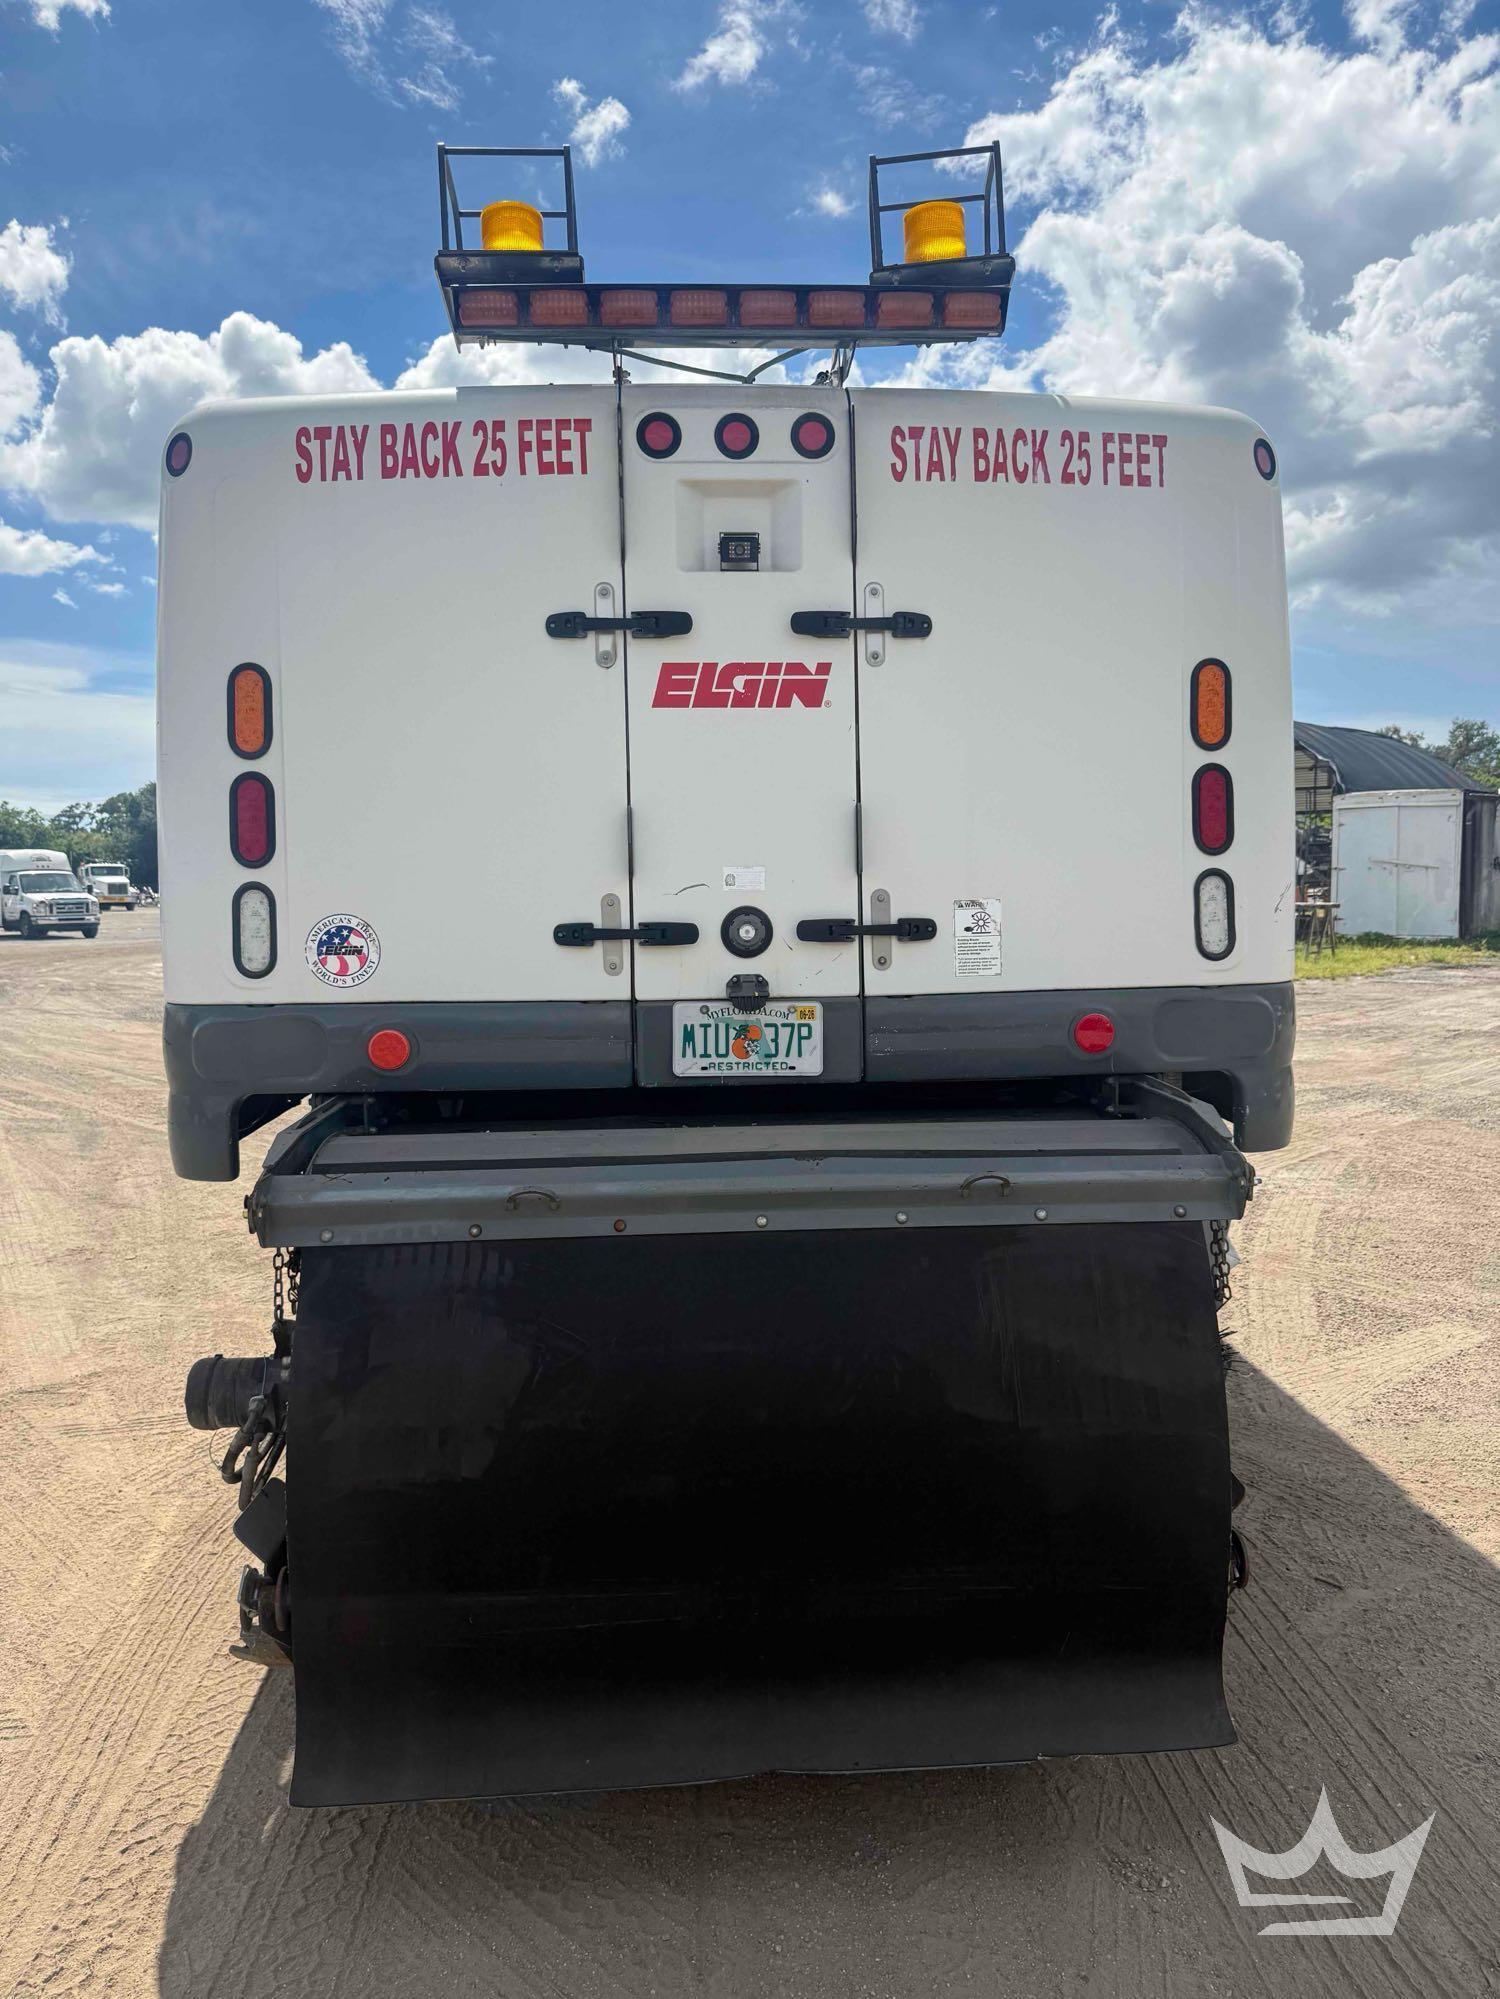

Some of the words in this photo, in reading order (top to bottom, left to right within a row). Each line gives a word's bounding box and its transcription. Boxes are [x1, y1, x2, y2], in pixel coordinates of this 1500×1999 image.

[295, 424, 370, 483] STAY
[380, 420, 464, 480] BACK
[472, 419, 508, 477] 25
[517, 418, 592, 476] FEET
[890, 425, 962, 482] STAY
[972, 427, 1051, 484] BACK
[1060, 429, 1092, 486] 25
[1101, 432, 1168, 488] FEET
[310, 917, 352, 944] AMERICA'S
[355, 921, 377, 943] FIRST
[324, 945, 364, 955] ELGIN
[312, 960, 347, 985] WORLD'S
[351, 959, 376, 983] FINEST
[681, 1023, 729, 1058] MIU
[764, 1023, 813, 1058] 37P
[708, 1062, 790, 1072] RESTRICTED
